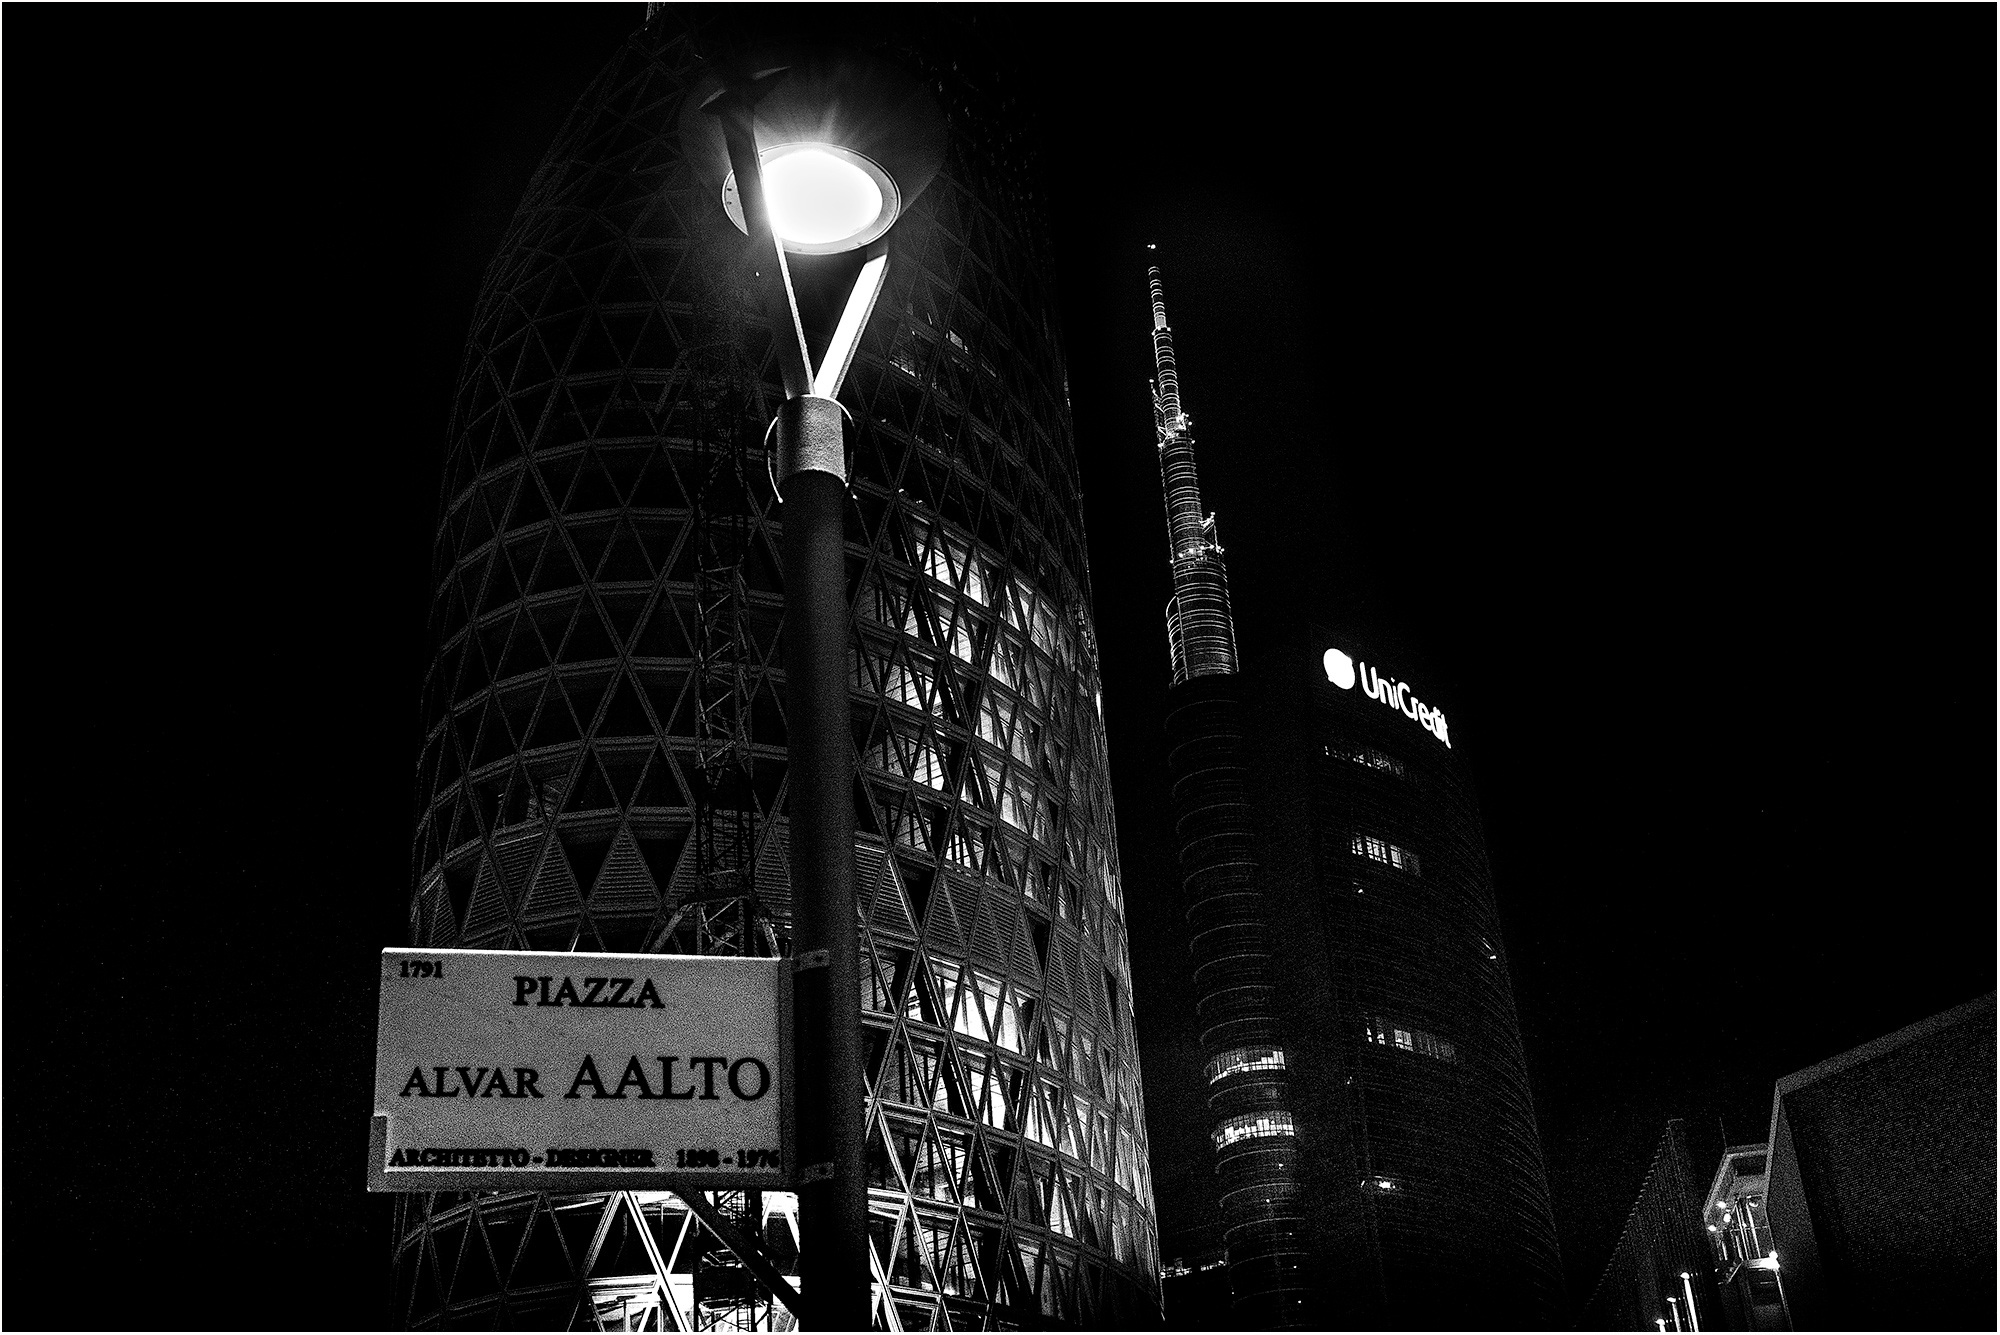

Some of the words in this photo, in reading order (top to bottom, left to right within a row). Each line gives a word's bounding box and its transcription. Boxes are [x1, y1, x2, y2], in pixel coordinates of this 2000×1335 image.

[1360, 661, 1452, 749] UniCredit
[399, 960, 443, 978] 1791
[513, 976, 666, 1009] PIAZZA
[400, 1066, 545, 1099] ALVAR
[564, 1054, 772, 1101] AALTO
[389, 1148, 531, 1168] ARCHITETTO
[546, 1149, 657, 1168] DESIGNER
[736, 1150, 781, 1169] 1976
